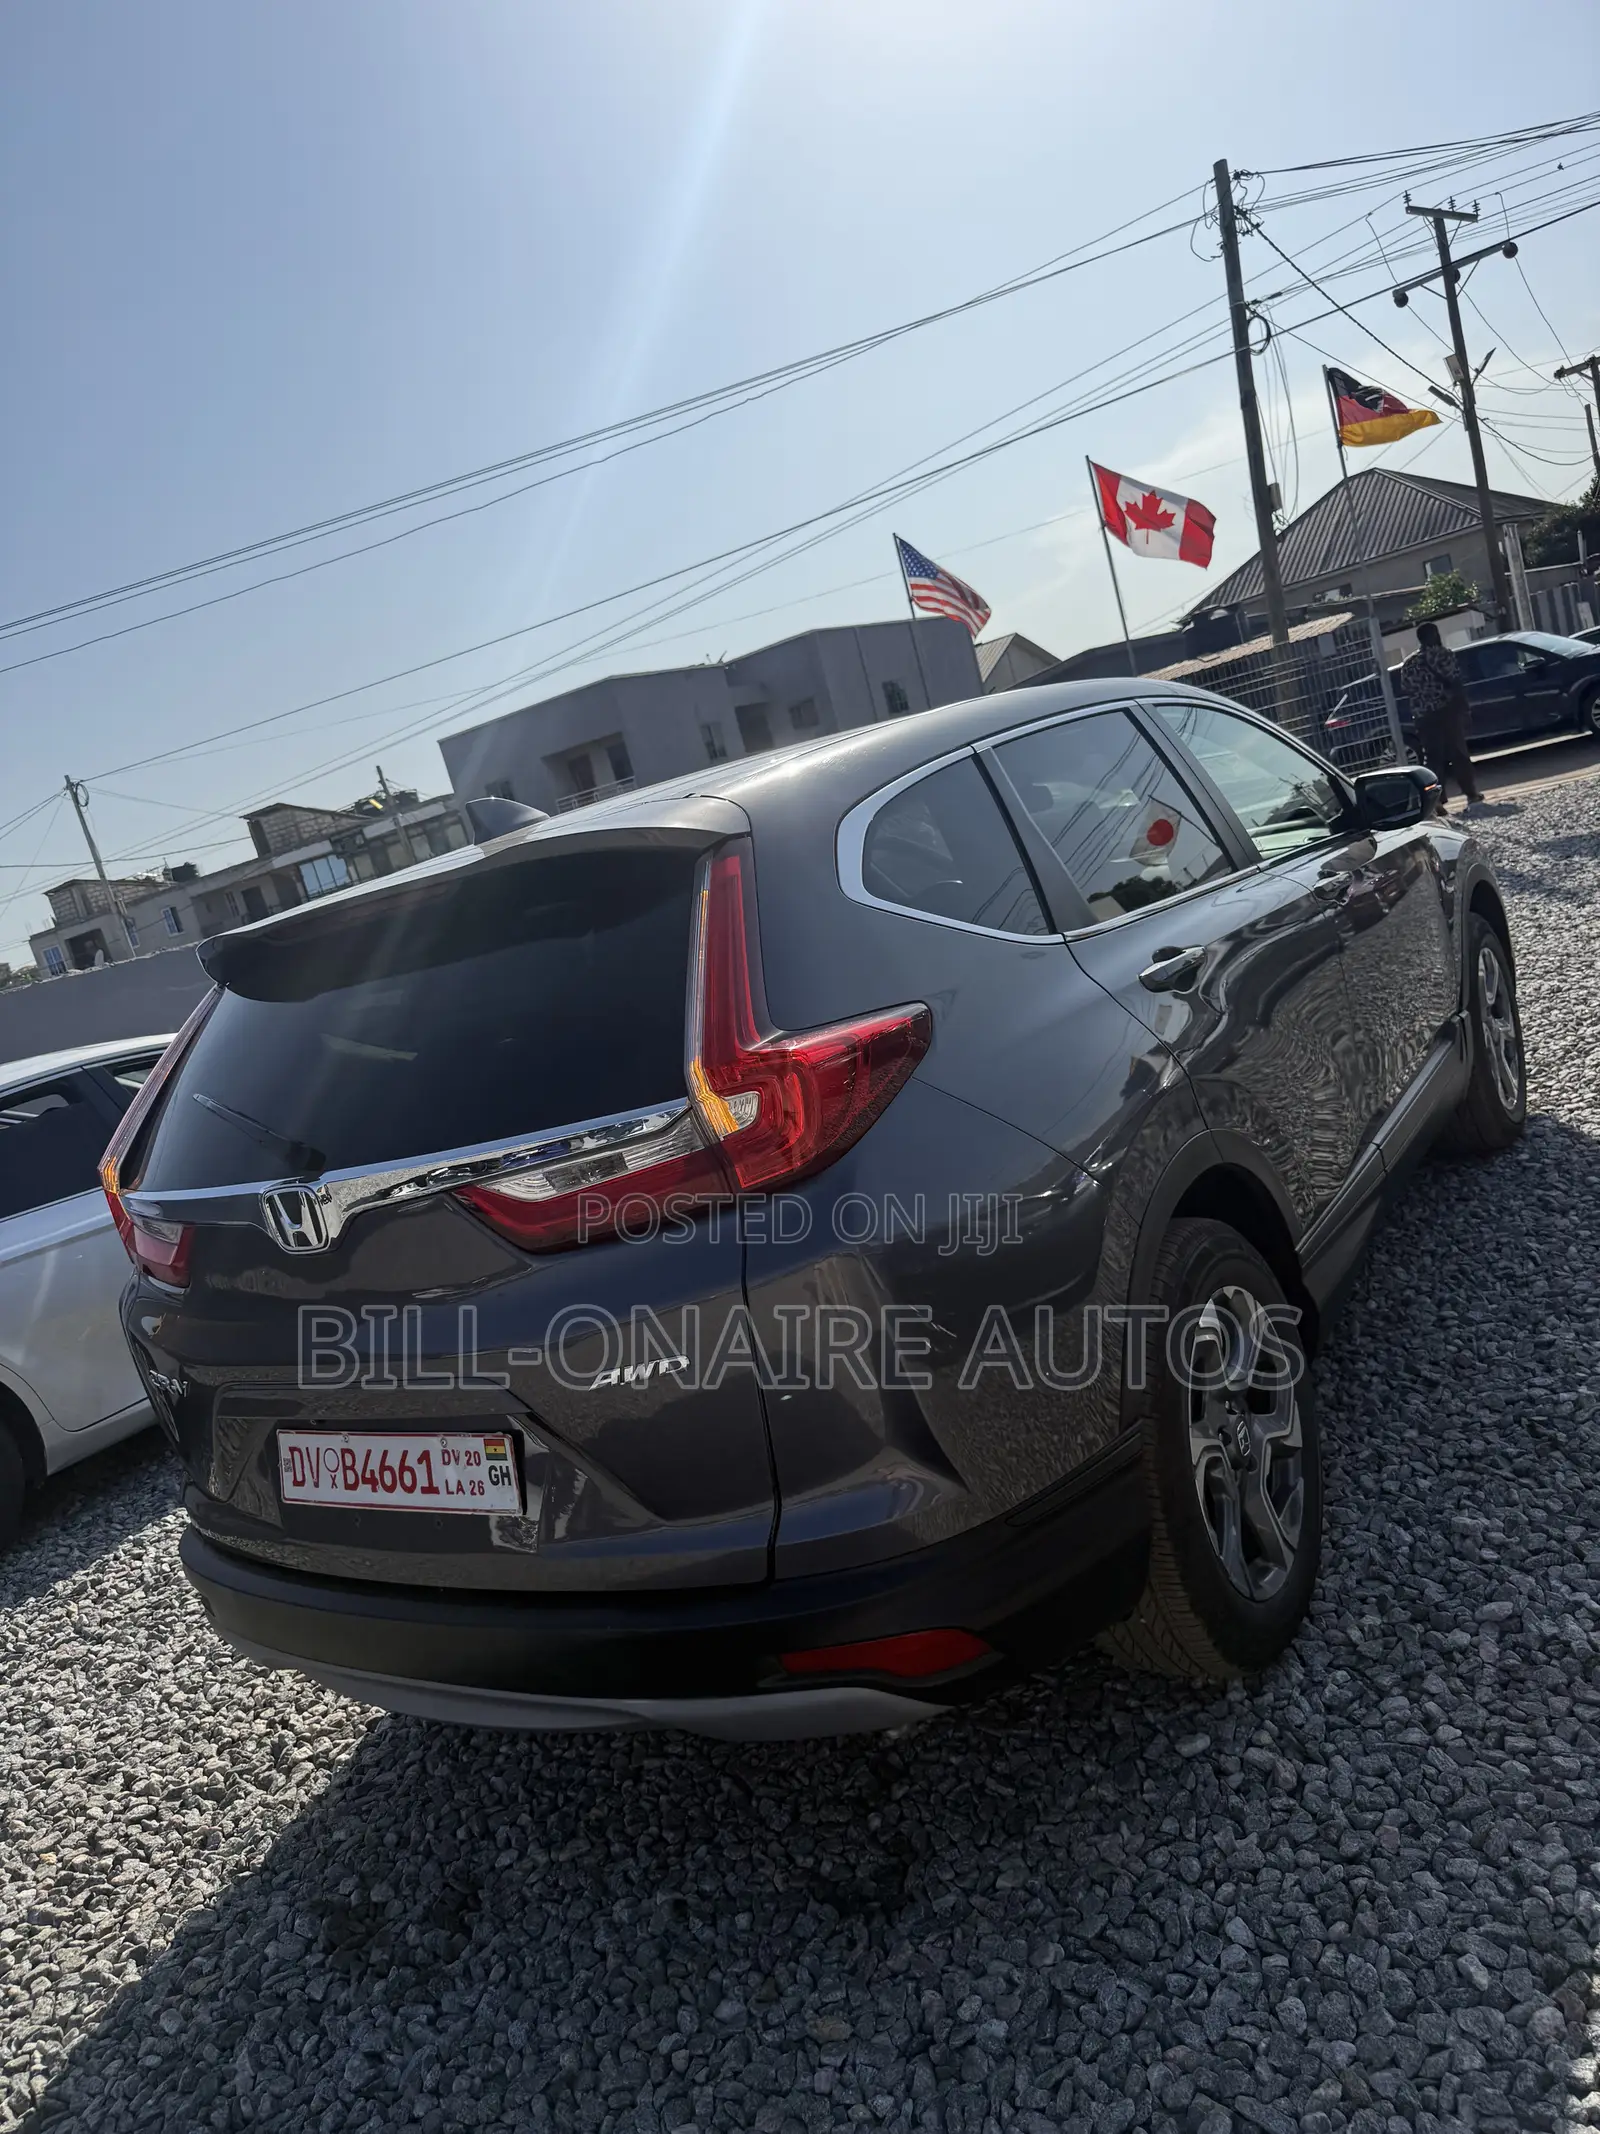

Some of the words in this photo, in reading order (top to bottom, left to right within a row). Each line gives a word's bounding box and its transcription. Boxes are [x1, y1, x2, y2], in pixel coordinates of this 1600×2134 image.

[588, 1354, 690, 1391] AWD
[441, 1448, 460, 1467] DV
[465, 1450, 482, 1467] 20
[340, 1447, 440, 1495] B4661
[488, 1465, 512, 1487] GH
[445, 1479, 465, 1495] LA
[469, 1479, 485, 1496] 26
